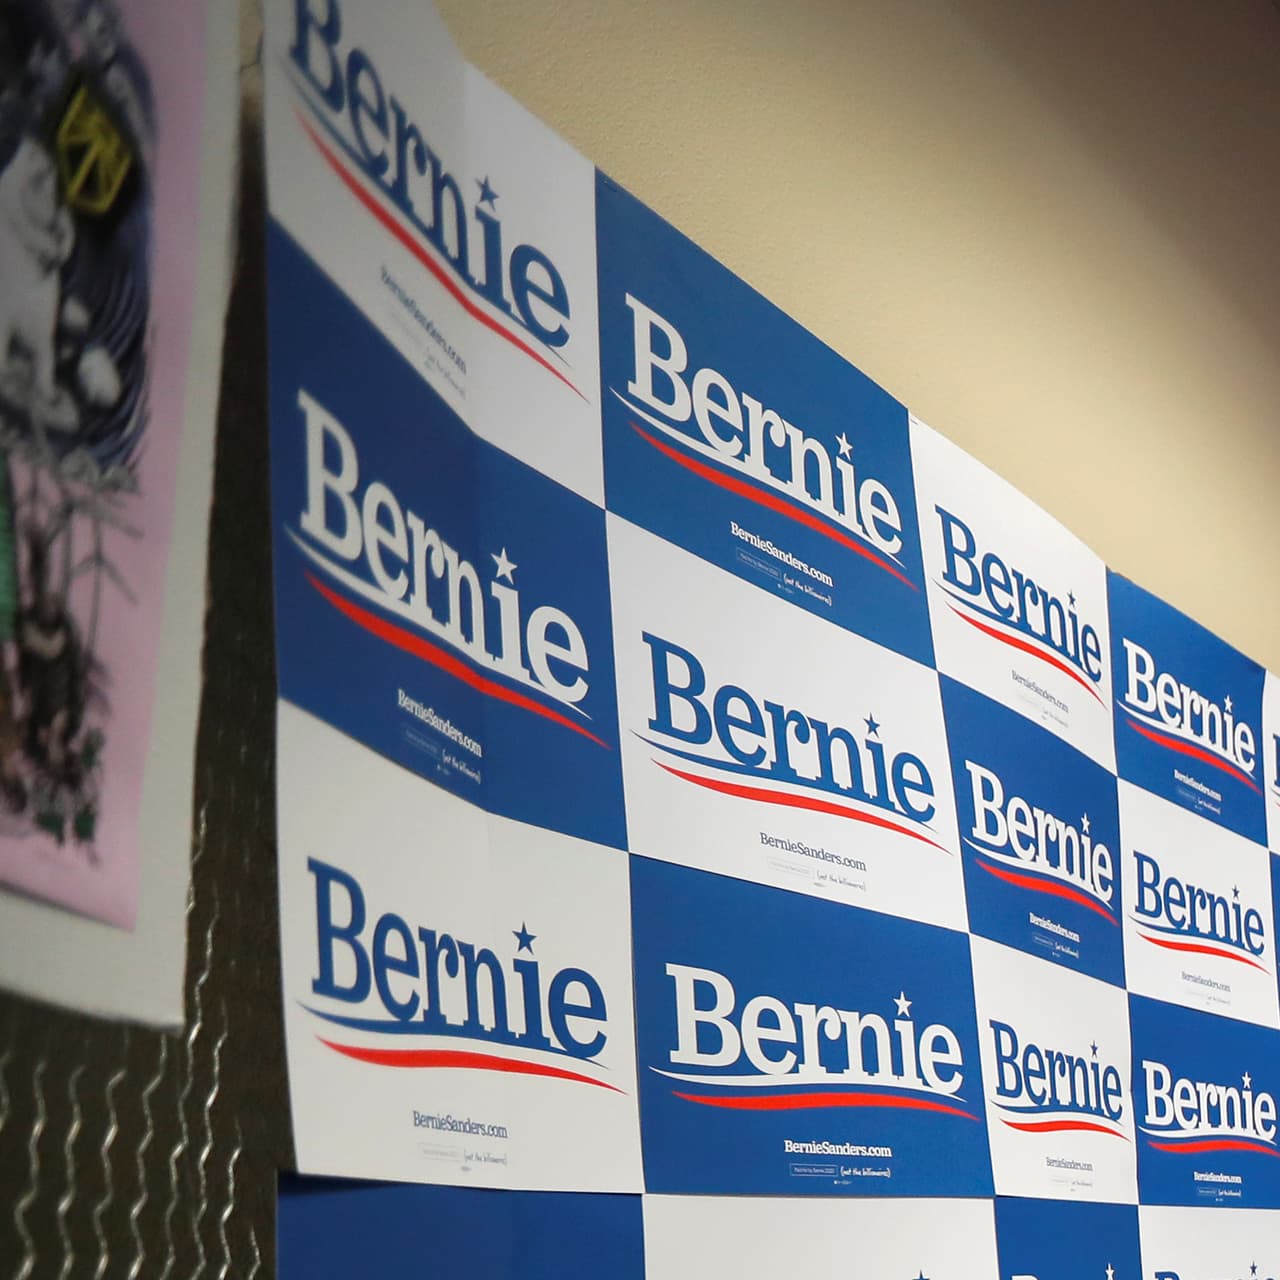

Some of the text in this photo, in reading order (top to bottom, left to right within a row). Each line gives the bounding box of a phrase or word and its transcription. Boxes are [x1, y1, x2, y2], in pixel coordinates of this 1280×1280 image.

[626, 292, 902, 554] Bernie
[298, 388, 589, 703] Bernie
[730, 521, 834, 587] BernieSanders.com
[935, 504, 1102, 682] Bernie
[398, 688, 482, 758] BernieSanders.com
[642, 630, 935, 822] Bernie
[1123, 638, 1255, 772] Bernie
[760, 832, 867, 871] BernieSanders.com
[965, 760, 1113, 894] Bernie
[307, 856, 607, 1058] Bernie
[1133, 850, 1264, 957] Bernie
[666, 962, 963, 1094] Bernie
[989, 1019, 1122, 1121] Bernie
[413, 1110, 508, 1138] BernieSanders.com
[784, 1139, 892, 1157] BernieSanders.com
[1142, 1060, 1277, 1141] Bernie
